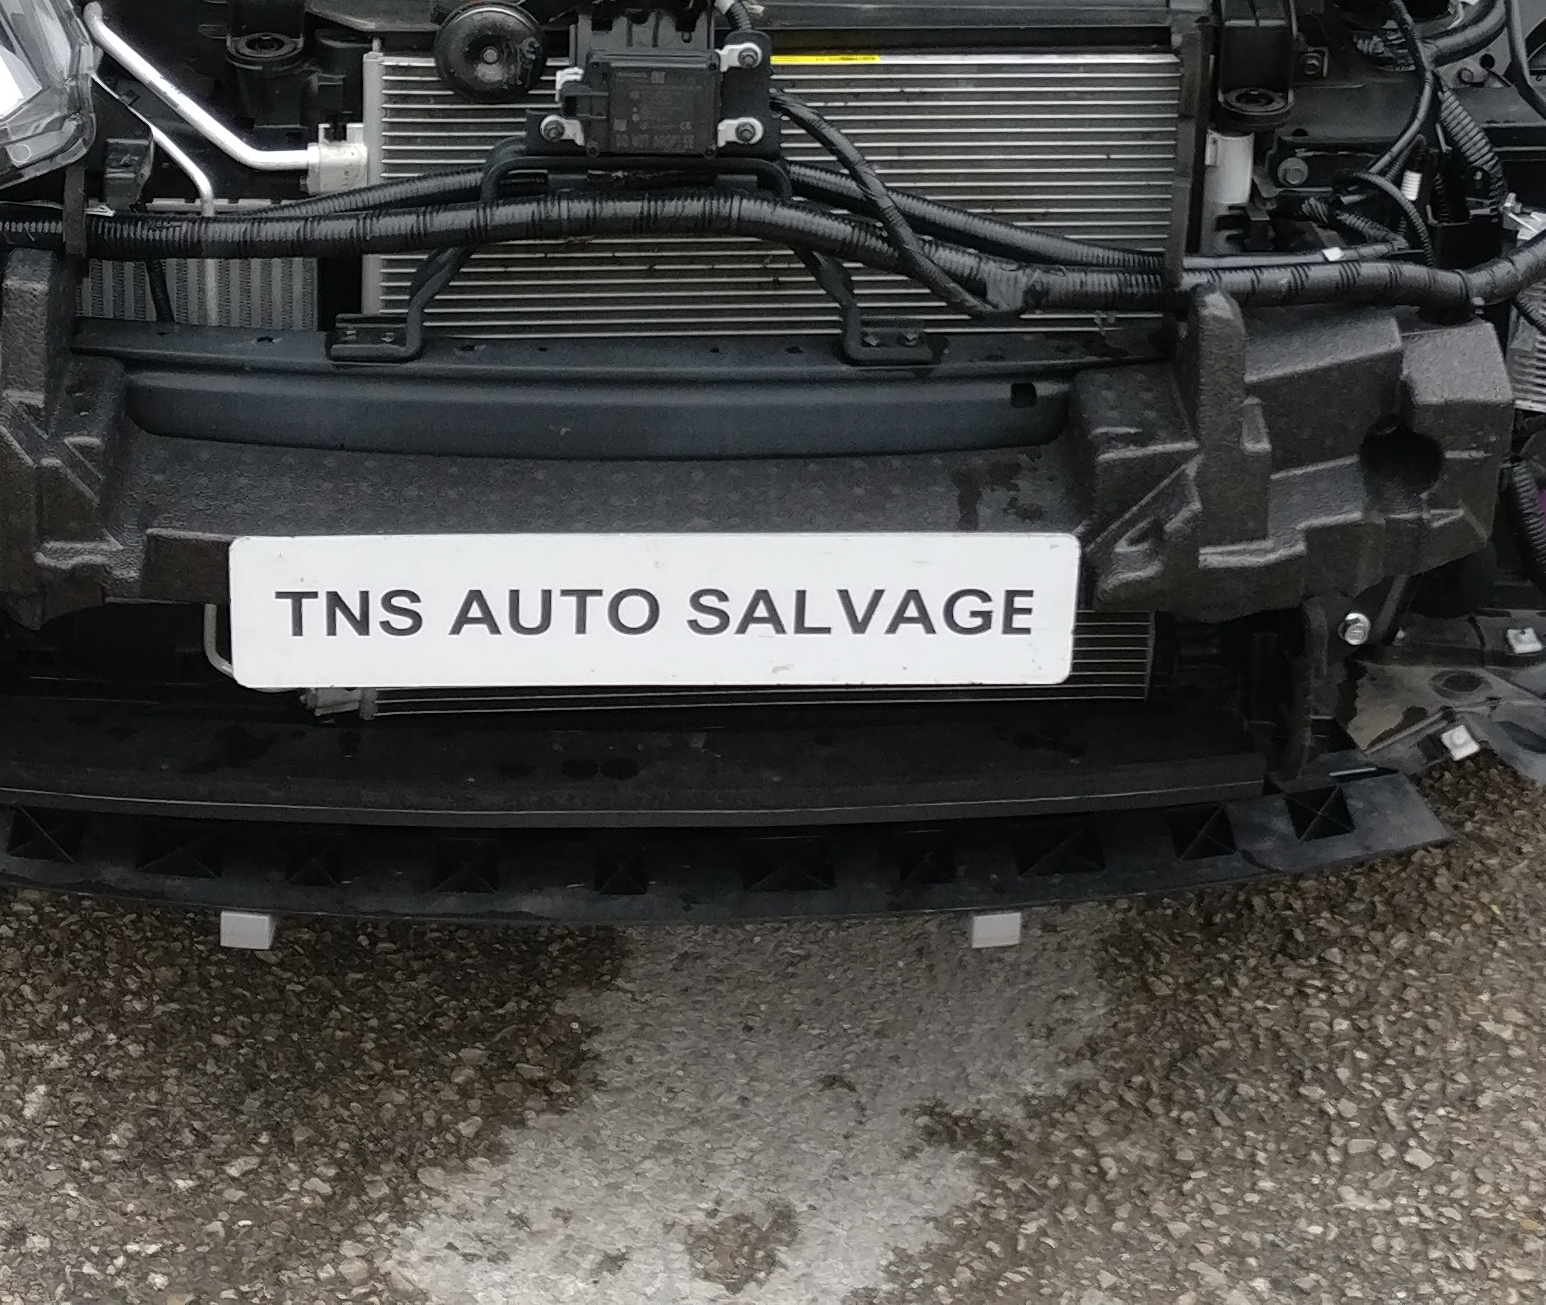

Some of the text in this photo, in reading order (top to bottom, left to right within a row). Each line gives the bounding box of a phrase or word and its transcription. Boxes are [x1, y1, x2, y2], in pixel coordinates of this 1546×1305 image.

[275, 588, 1035, 637] TNS AUTO SALVAGE
